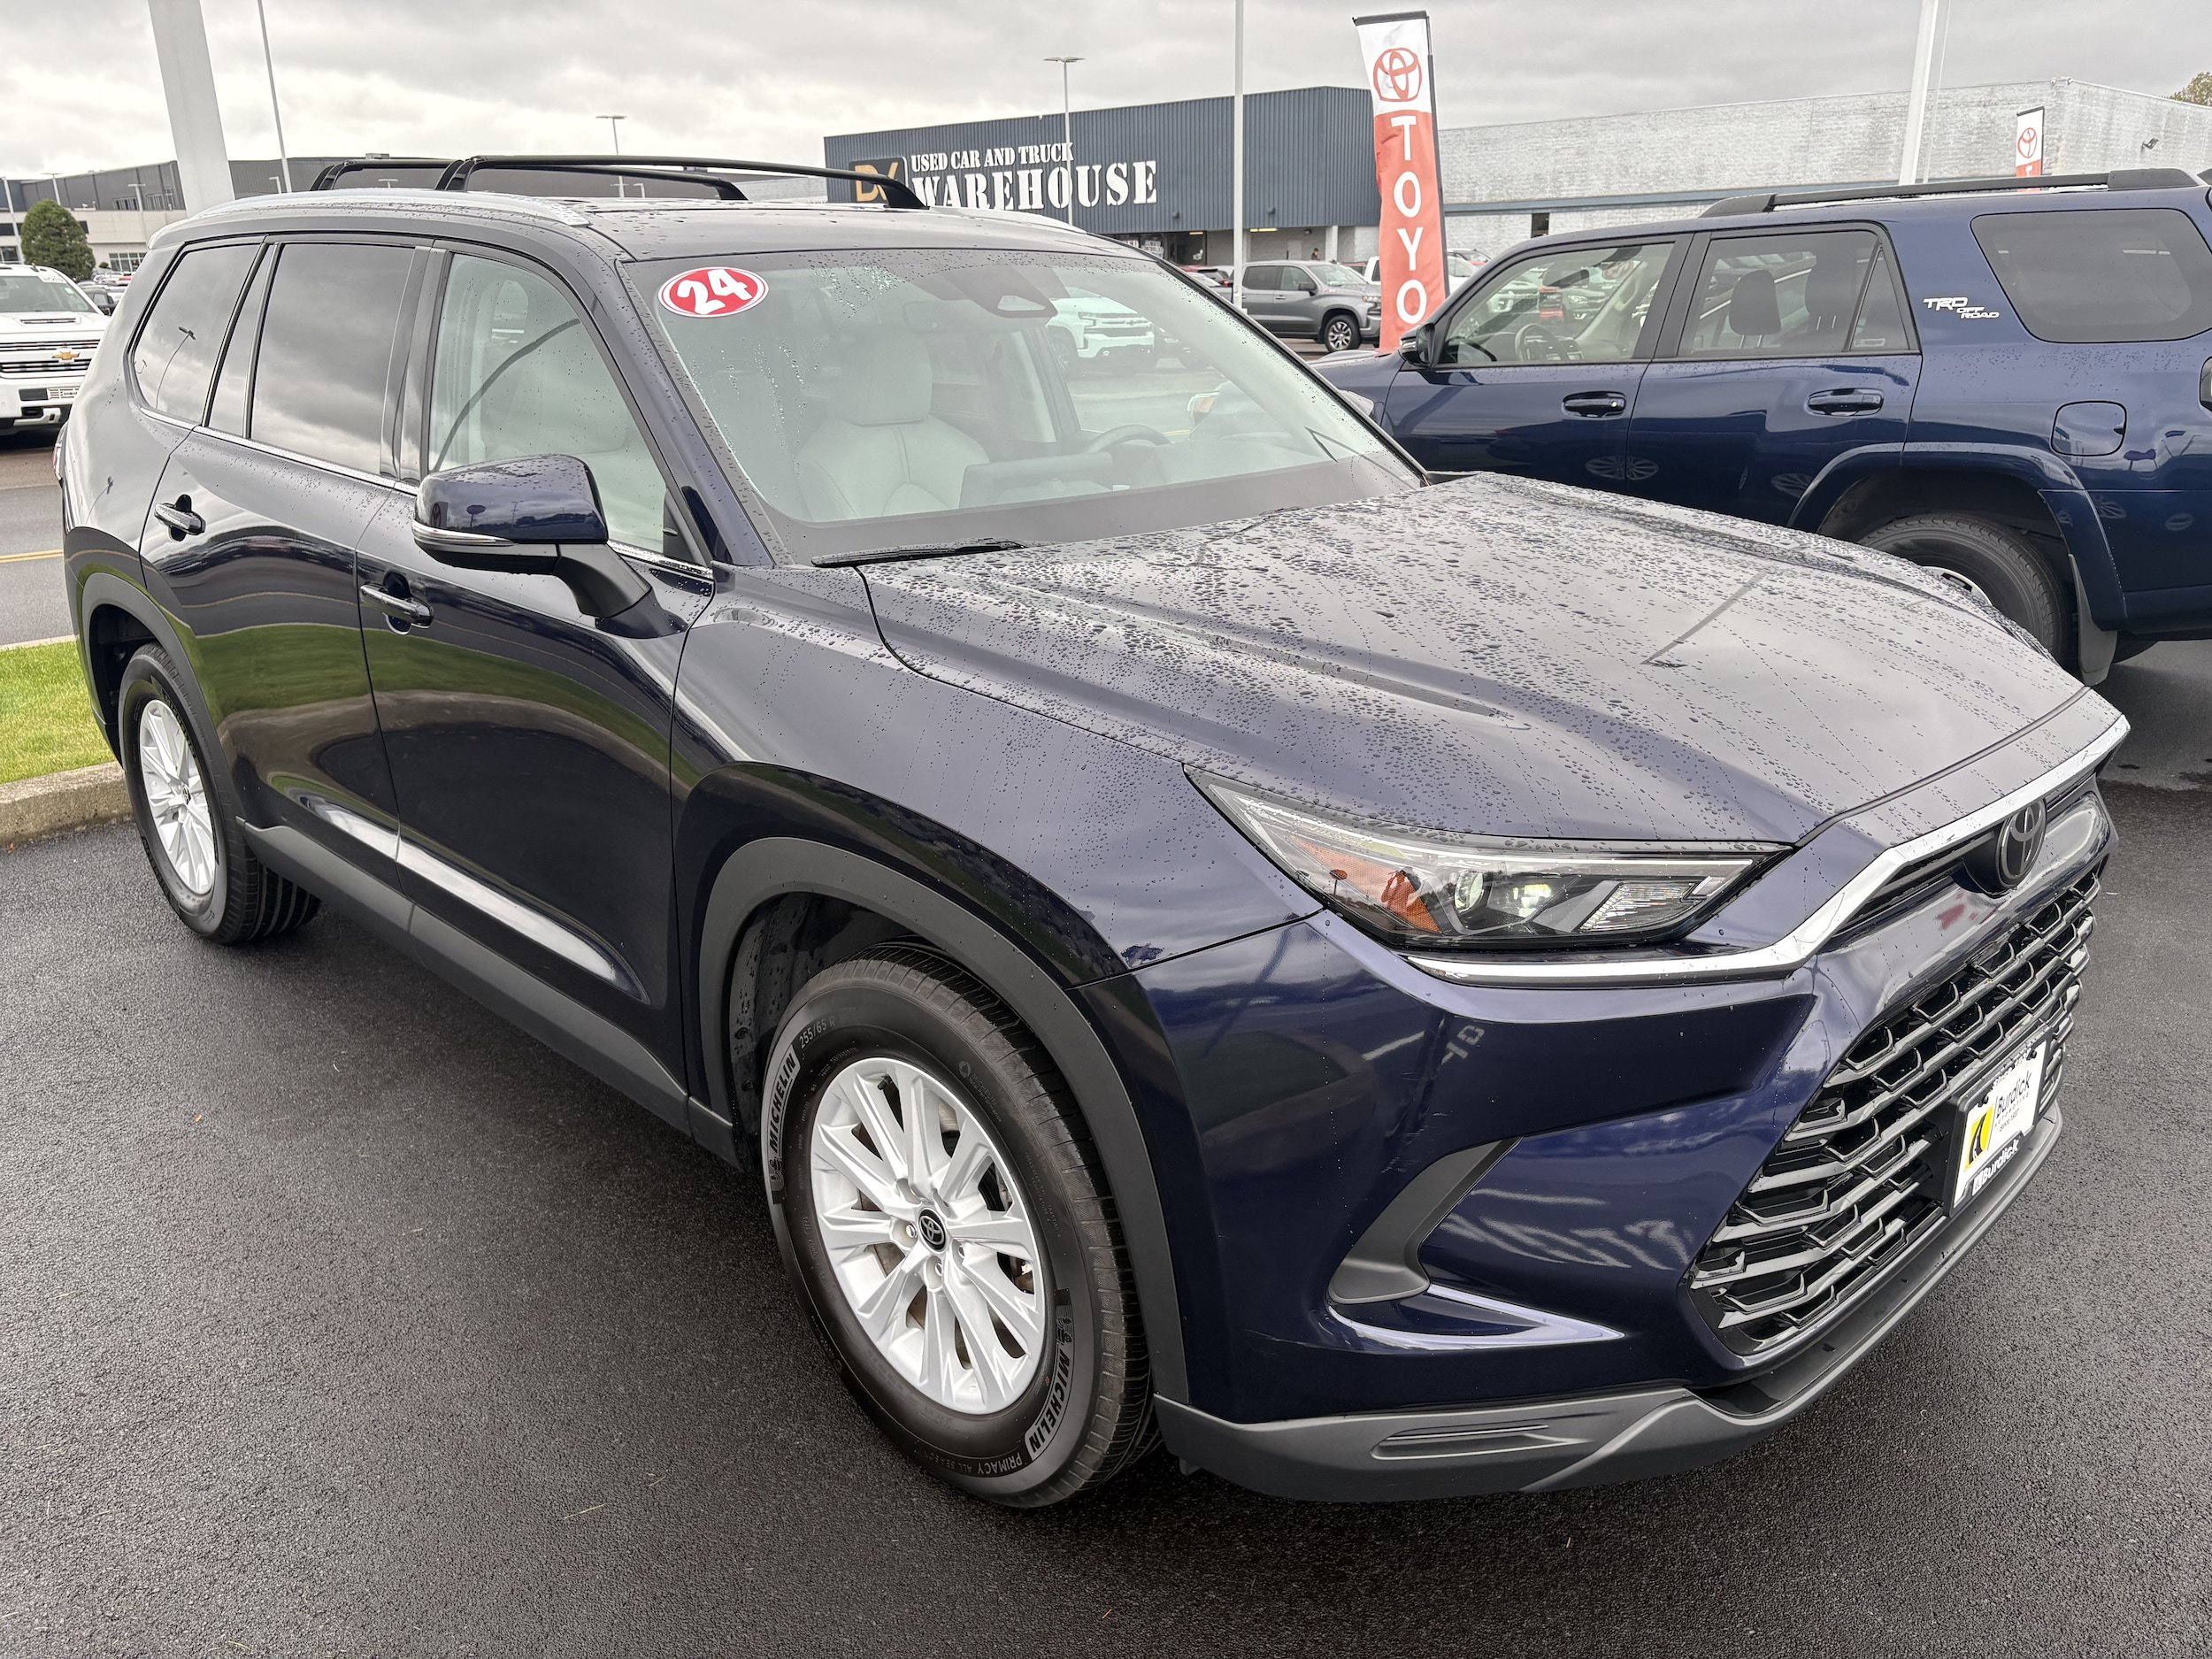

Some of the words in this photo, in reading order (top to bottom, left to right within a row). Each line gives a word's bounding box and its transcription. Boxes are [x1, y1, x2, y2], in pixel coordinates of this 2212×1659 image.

[910, 153, 948, 173] USED
[951, 150, 980, 169] CAR
[984, 147, 1016, 167] AND
[1018, 142, 1074, 165] TRUCK
[912, 160, 1157, 211] WAREHOUSE
[677, 269, 752, 315] 24
[1923, 296, 1968, 311] TRD
[799, 1018, 827, 1048] 255/65
[769, 1053, 796, 1154] MICHELIN
[1996, 1070, 2032, 1119] Burdick
[1981, 1139, 2019, 1186] Burdick
[1029, 1348, 1070, 1454] MICHELIN
[978, 1452, 1023, 1474] PRIMACY
